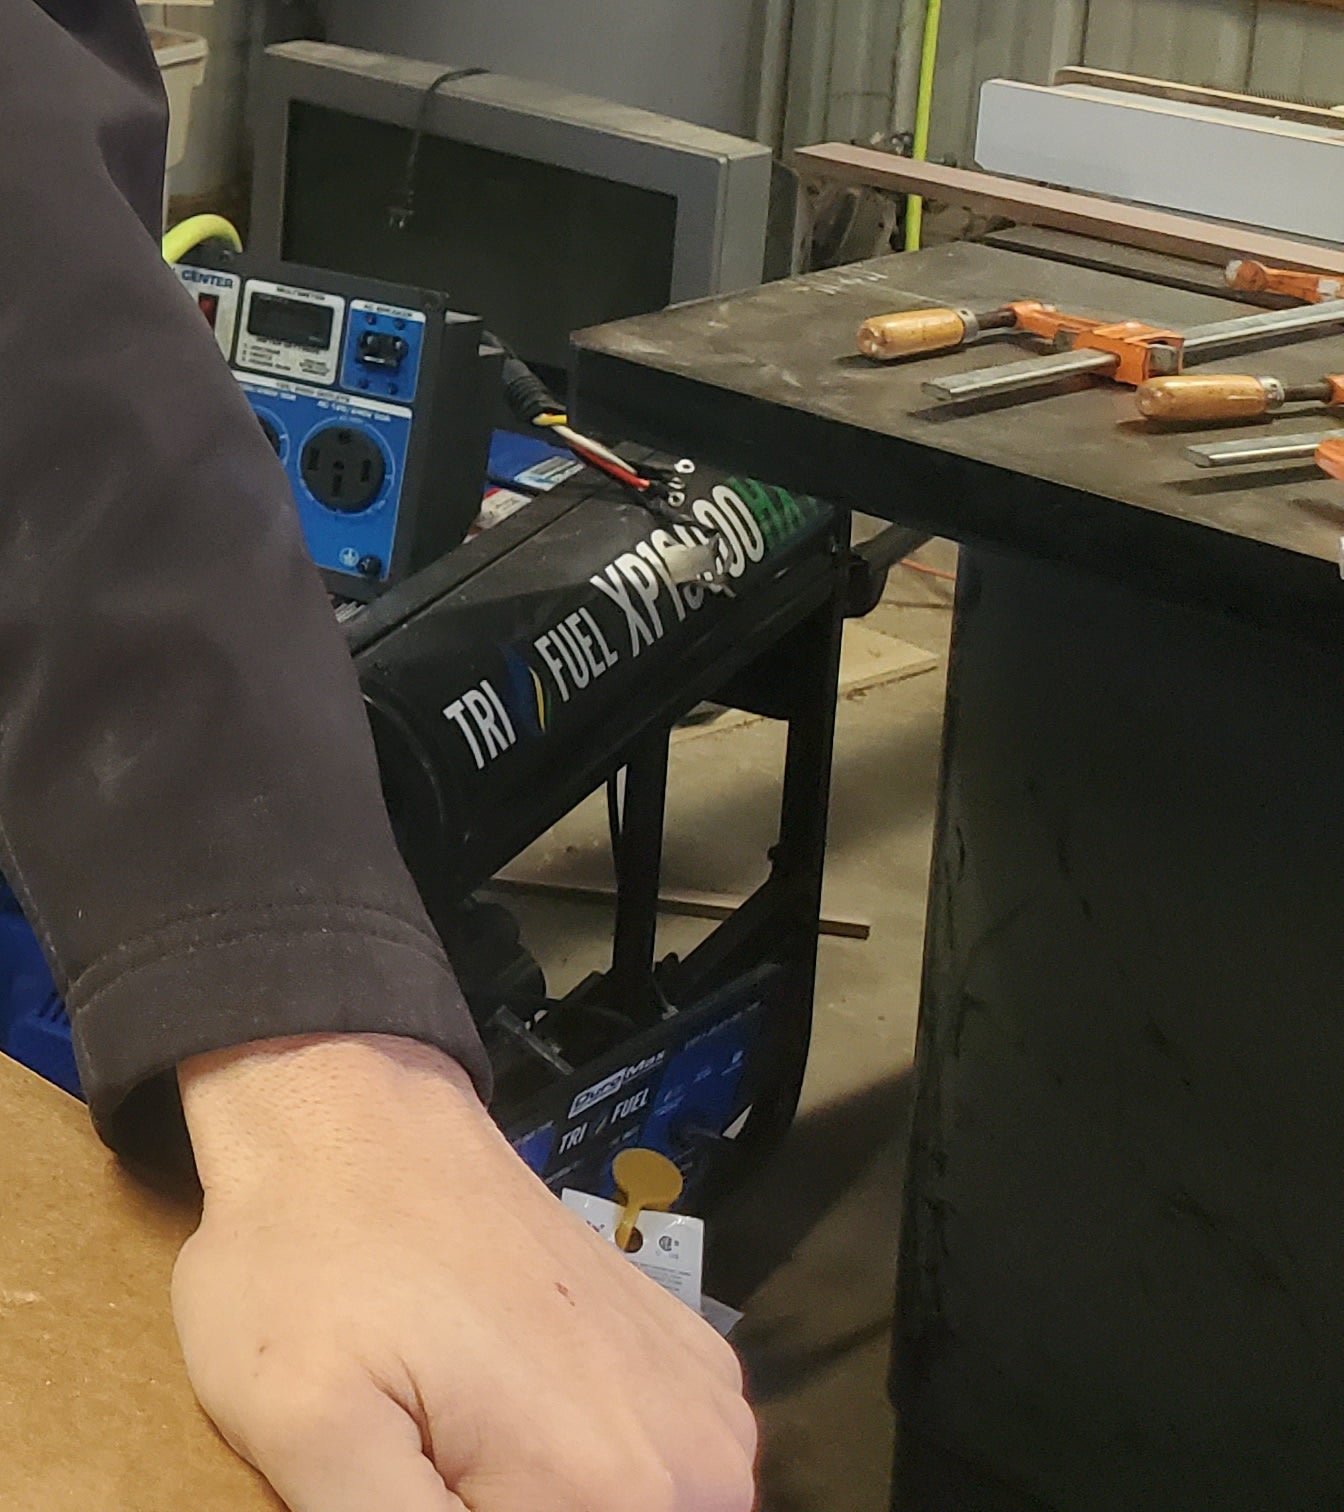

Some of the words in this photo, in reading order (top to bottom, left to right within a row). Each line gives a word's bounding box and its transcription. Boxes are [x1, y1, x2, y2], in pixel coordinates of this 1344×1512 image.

[181, 269, 234, 290] CENTER
[443, 680, 517, 769] TRI
[534, 607, 619, 703] FUEL
[558, 1122, 589, 1155] TRI
[610, 1087, 651, 1125] FUEL
